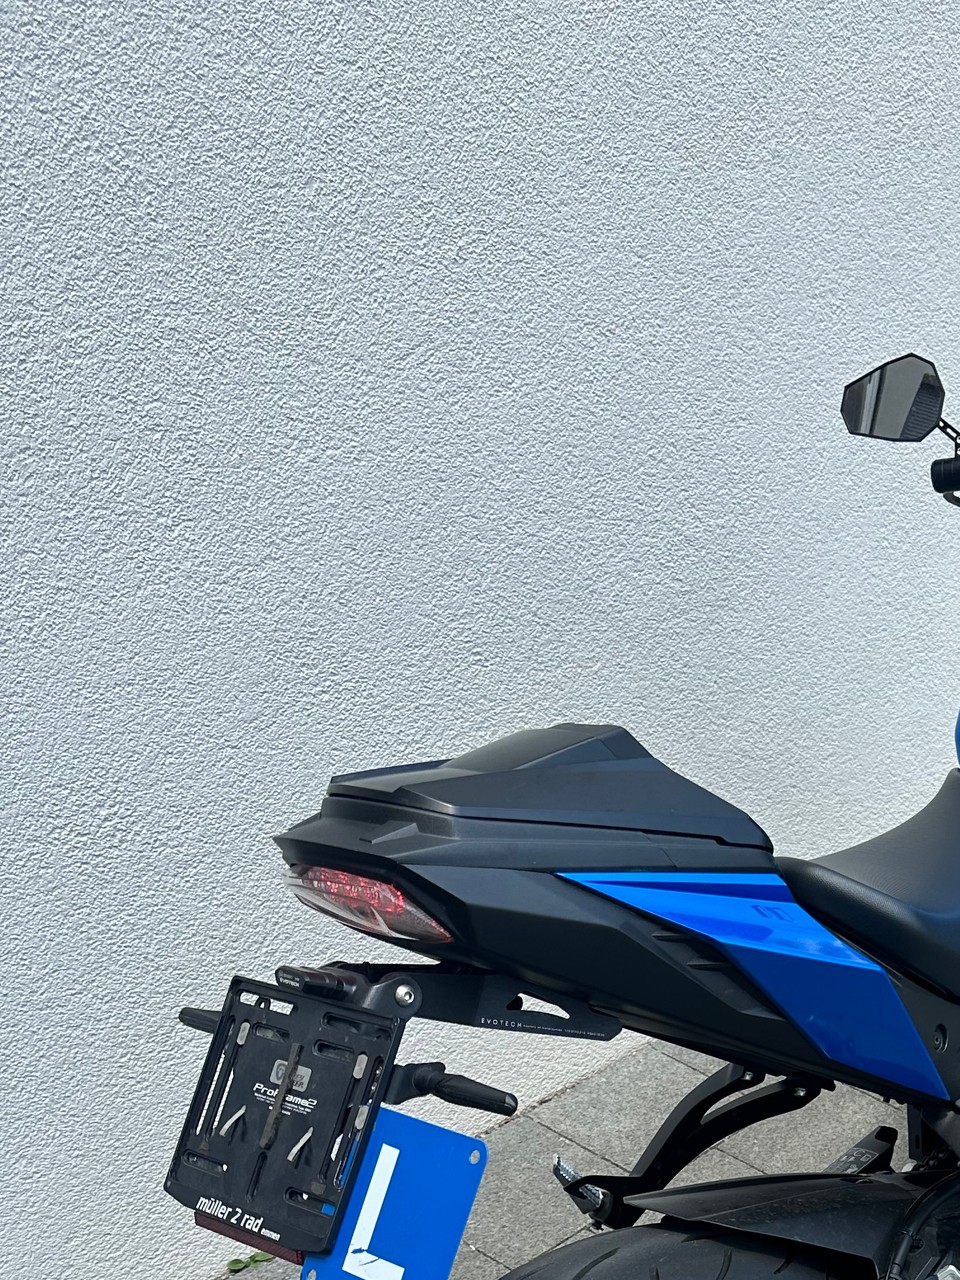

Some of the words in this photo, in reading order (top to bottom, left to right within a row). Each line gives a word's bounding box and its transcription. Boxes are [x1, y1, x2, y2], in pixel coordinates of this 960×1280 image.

[480, 1017, 522, 1029] EVOTECH
[196, 1196, 232, 1220] müller
[230, 1207, 242, 1224] 2
[240, 1213, 264, 1233] rad
